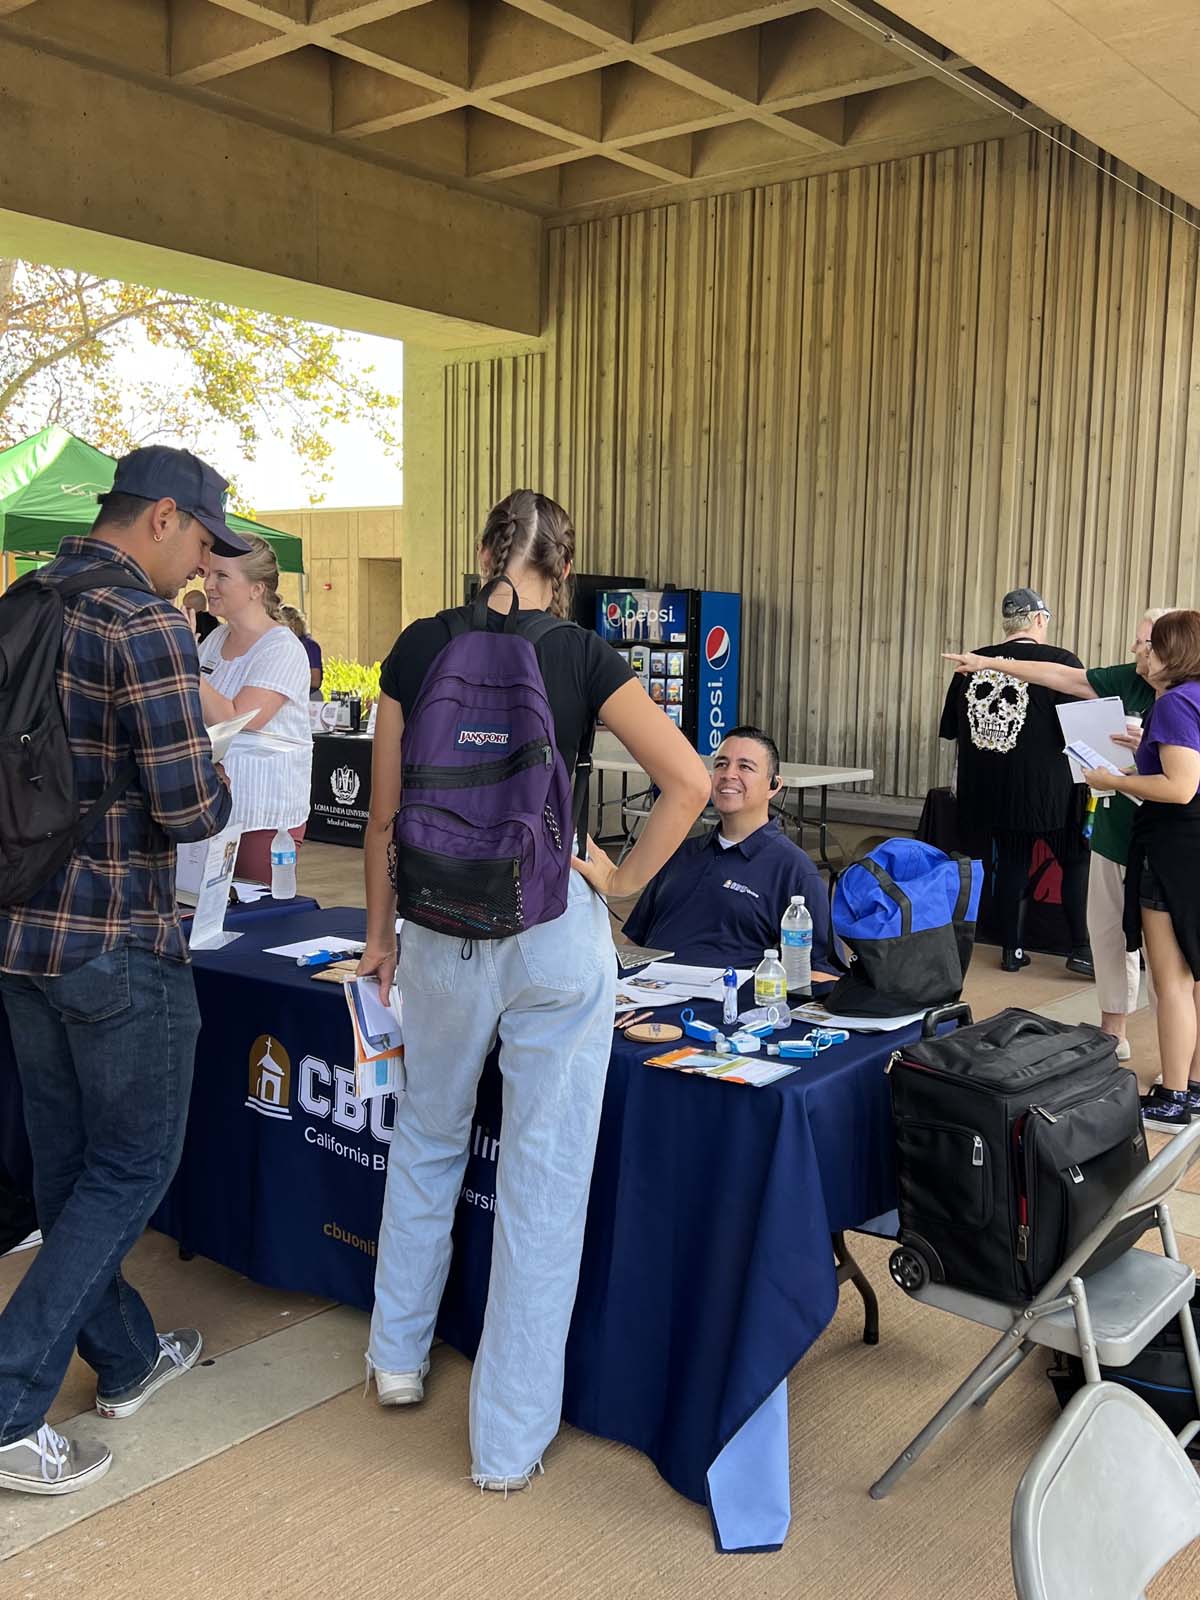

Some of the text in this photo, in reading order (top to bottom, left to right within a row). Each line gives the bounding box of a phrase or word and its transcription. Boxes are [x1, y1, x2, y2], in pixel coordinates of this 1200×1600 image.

[625, 605, 673, 627] pepsi
[708, 681, 725, 757] epsi
[458, 730, 509, 746] JANSPORT
[314, 803, 330, 813] LOMA
[330, 805, 346, 815] LINDA
[304, 1126, 369, 1167] California
[373, 1153, 386, 1171] B
[323, 1222, 376, 1257] cbuonli
